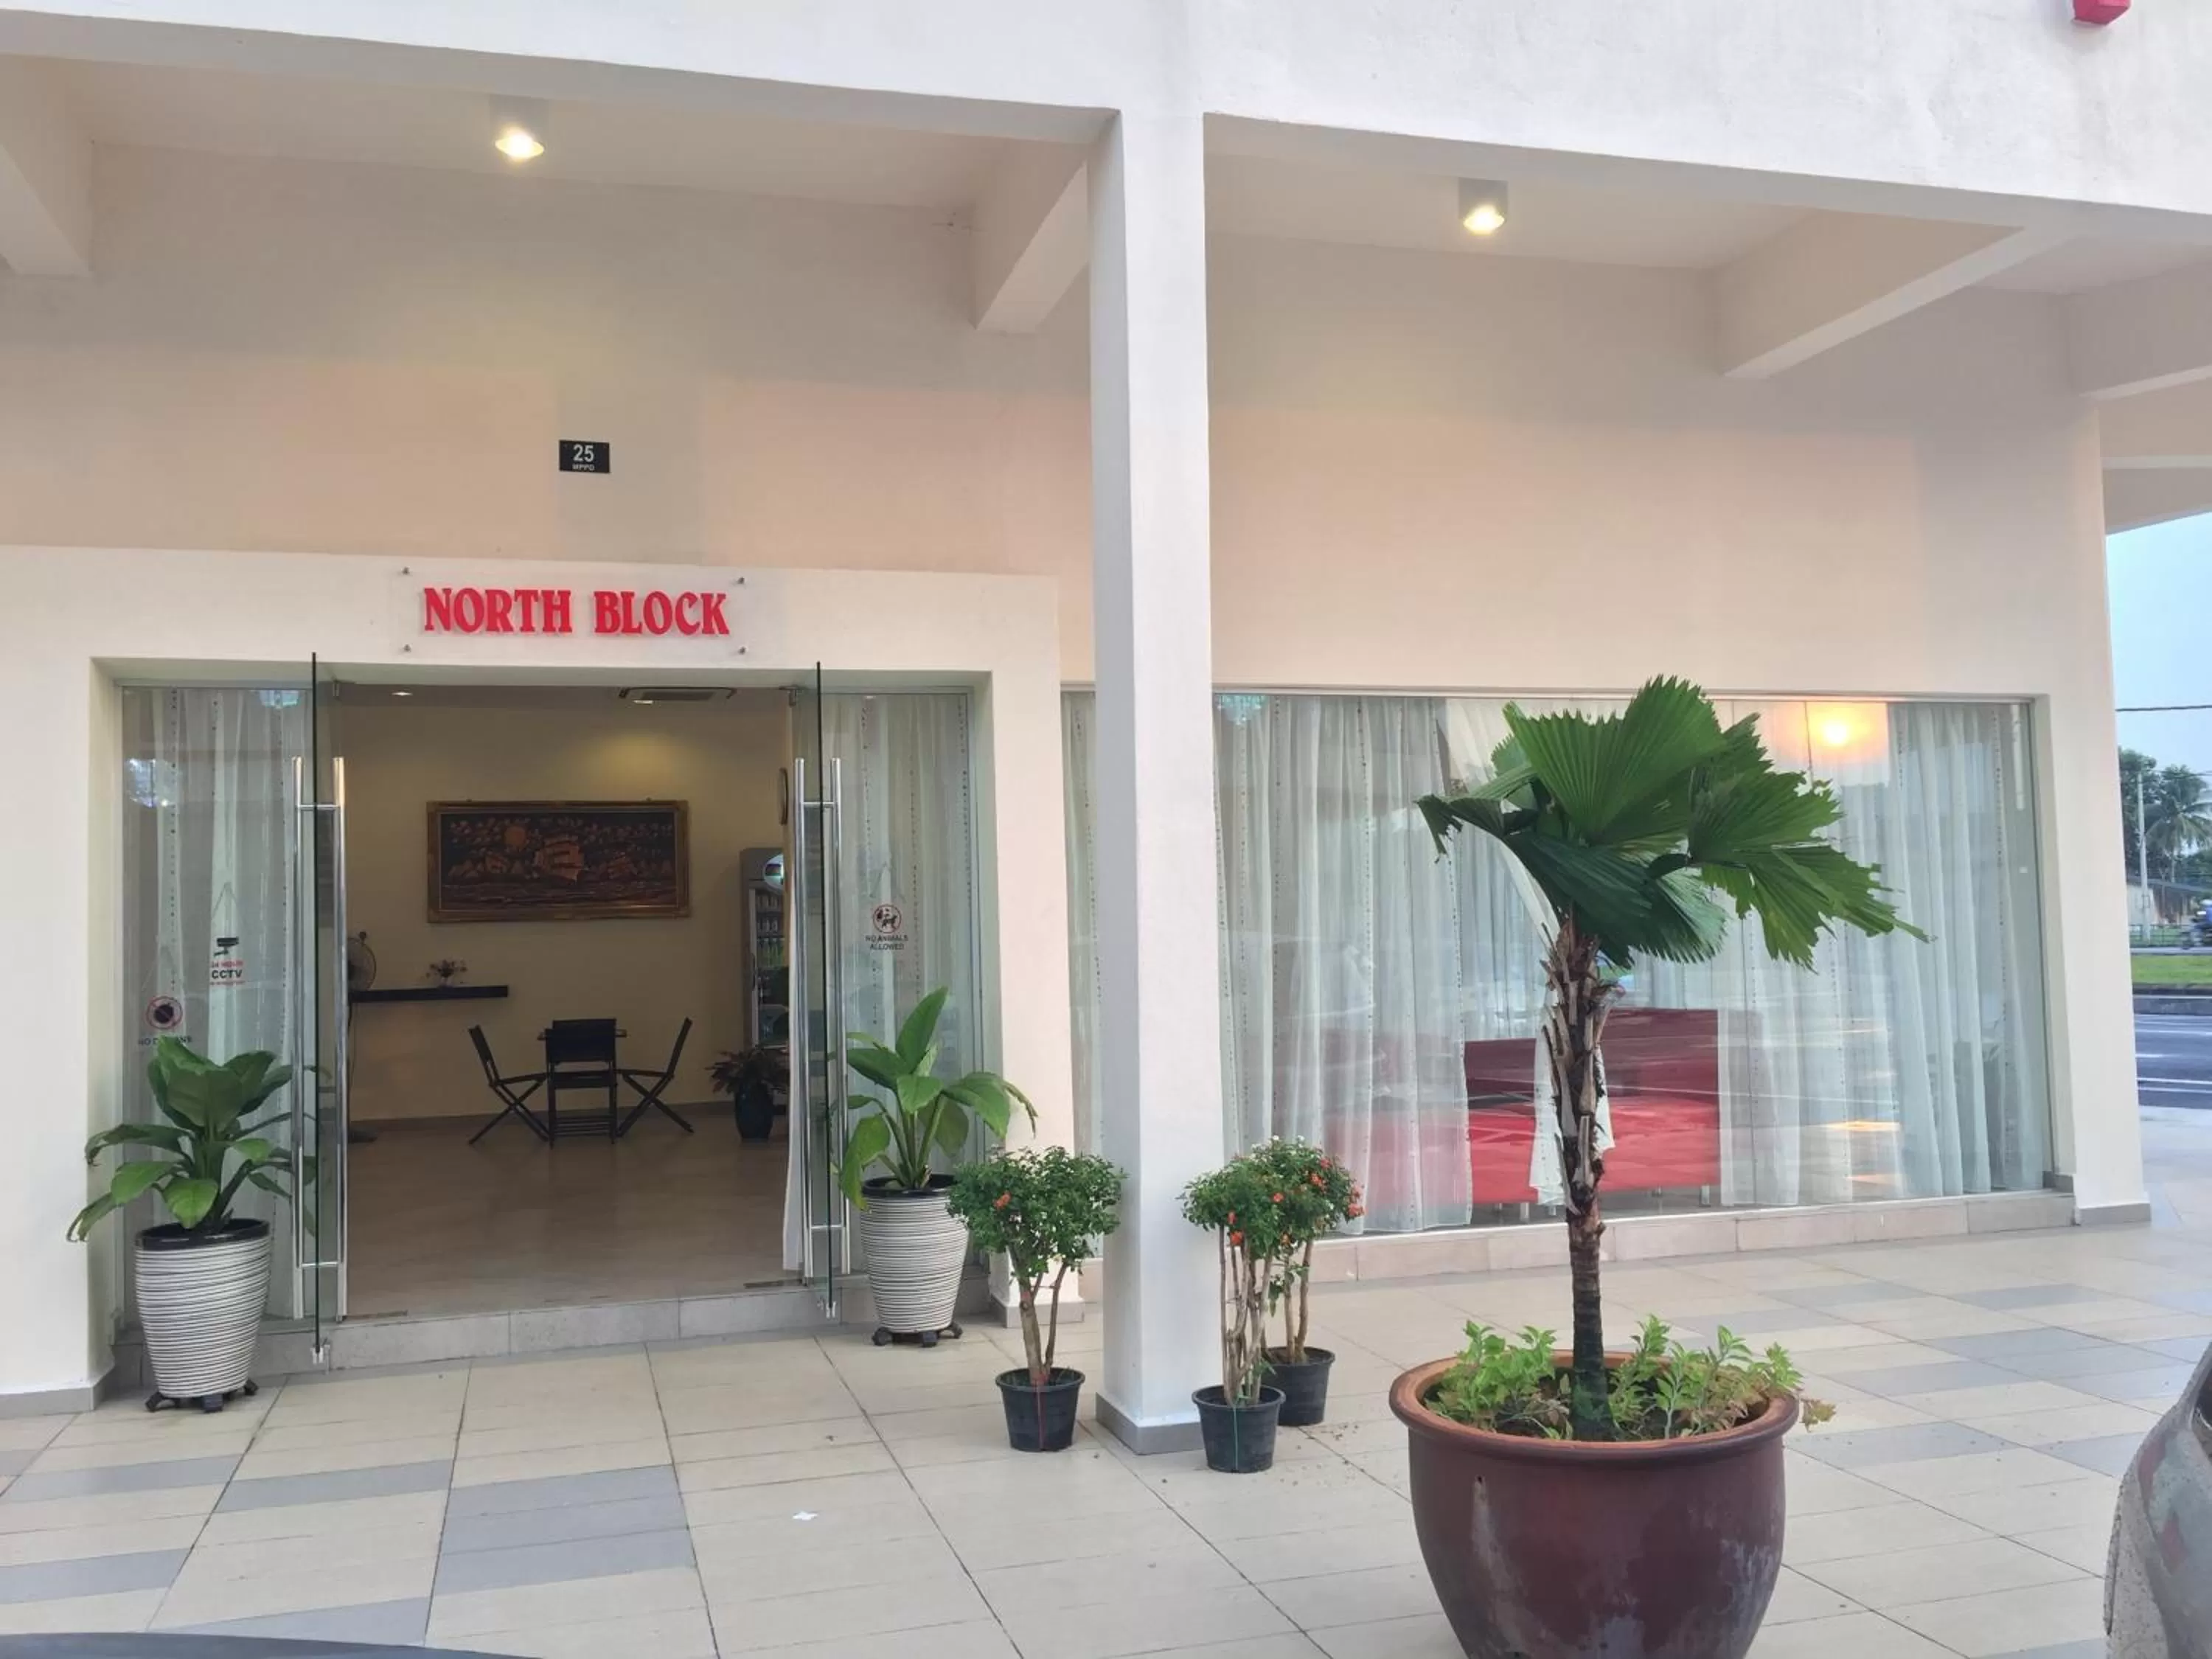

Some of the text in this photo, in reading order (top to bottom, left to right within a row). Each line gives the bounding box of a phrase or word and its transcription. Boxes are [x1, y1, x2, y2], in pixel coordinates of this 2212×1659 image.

[573, 444, 594, 462] 25
[425, 588, 730, 636] NORTH BLOCK
[865, 934, 877, 942] NO
[212, 970, 243, 979] CCTV
